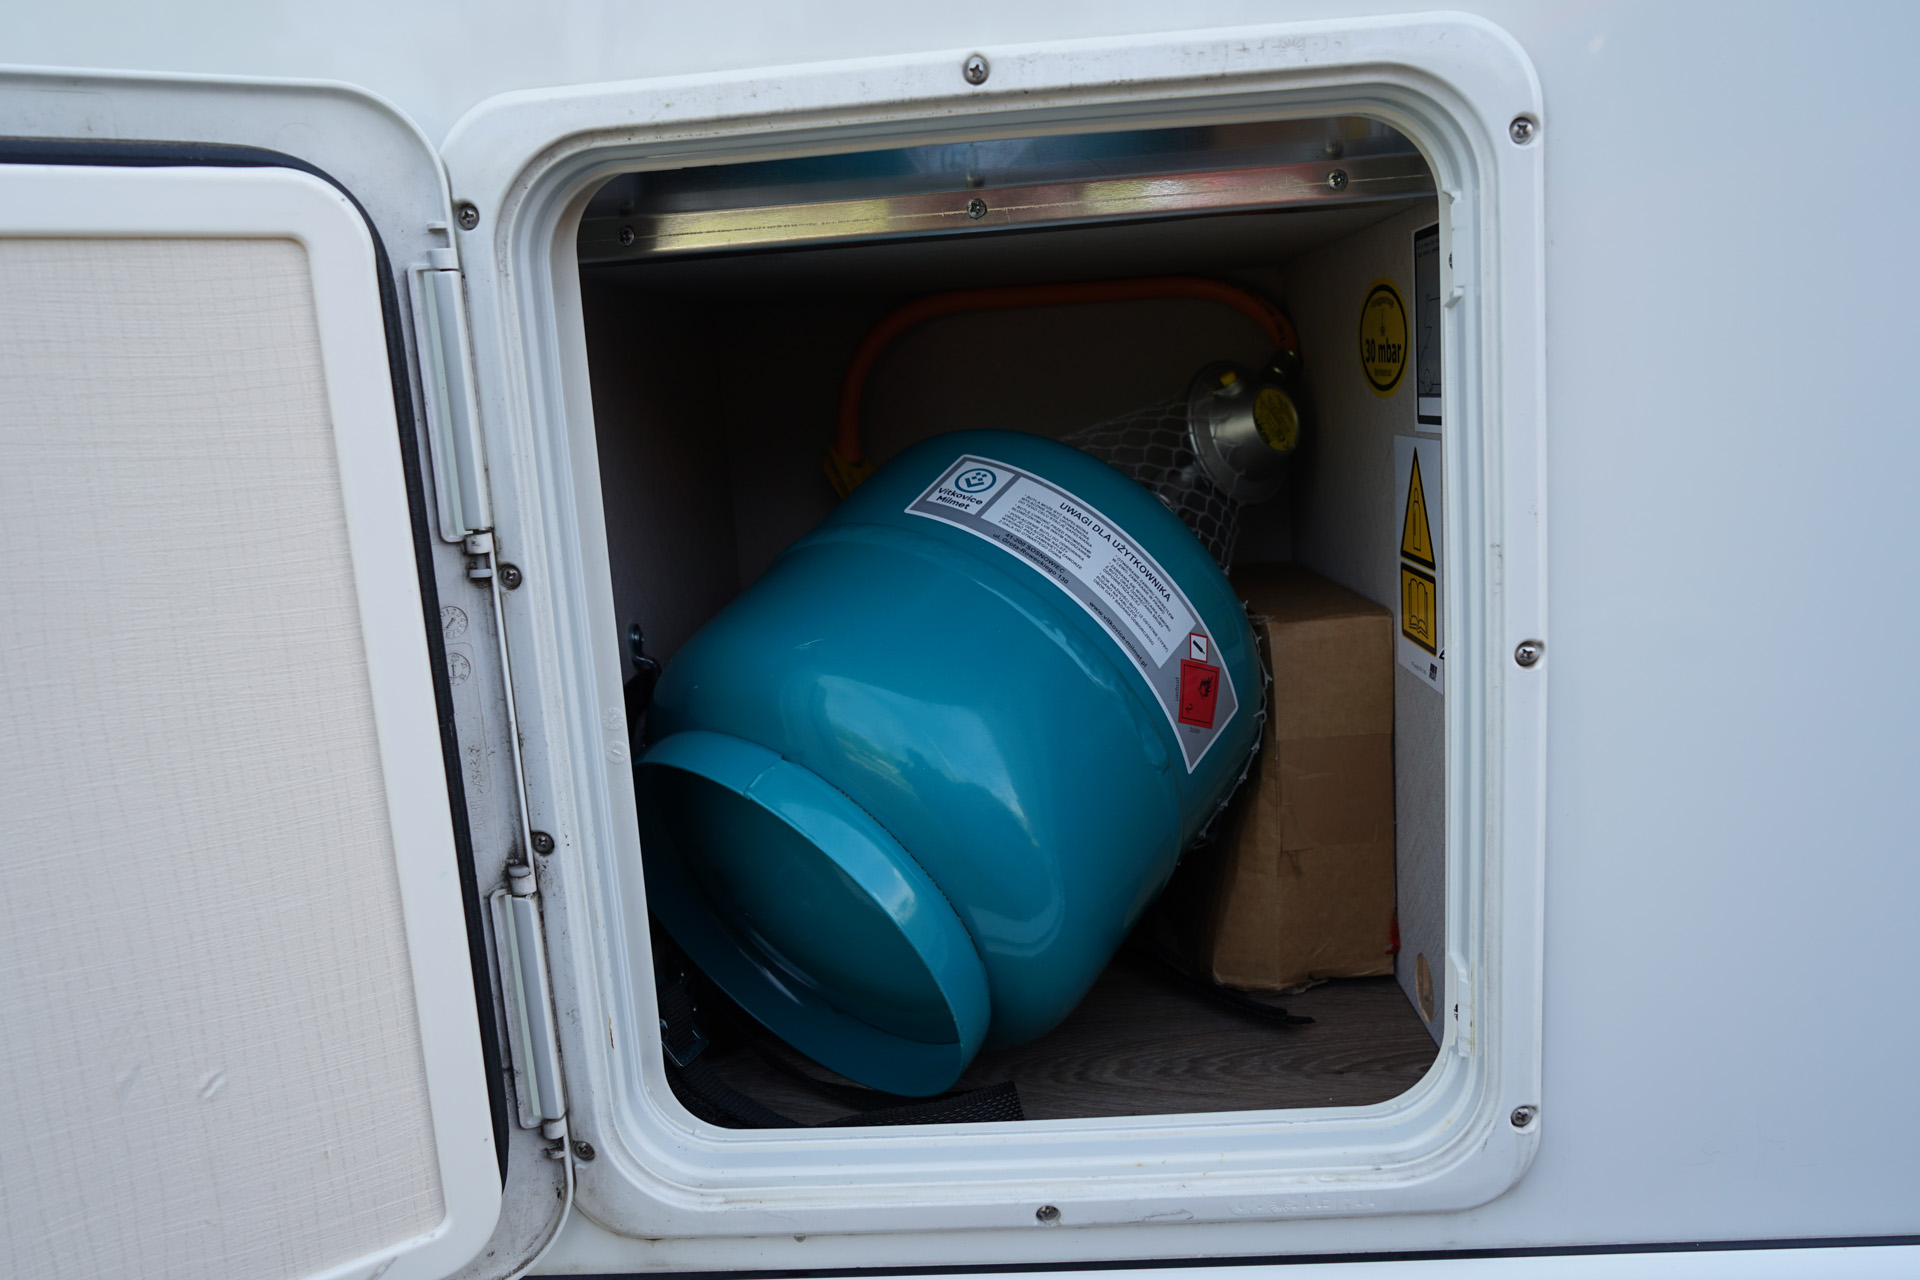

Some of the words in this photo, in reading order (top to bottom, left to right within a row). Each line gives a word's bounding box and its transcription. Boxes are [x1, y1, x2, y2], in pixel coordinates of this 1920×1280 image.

[1365, 338, 1376, 364] 30
[1378, 337, 1402, 364] mbar
[935, 495, 971, 509] Milmet
[937, 487, 984, 506] Vitkovice
[1002, 537, 1057, 575] Grota-Roweckiego
[1058, 574, 1069, 584] 130
[1005, 533, 1026, 546] 41-200
[1025, 545, 1066, 573] SOSNOWIEC
[1059, 503, 1092, 526] UWAGI
[1092, 525, 1112, 542] DLA
[1112, 539, 1173, 602] UŻYTKOWNIKA
[1089, 601, 1148, 668] www.vitkovice-milmet.pl
